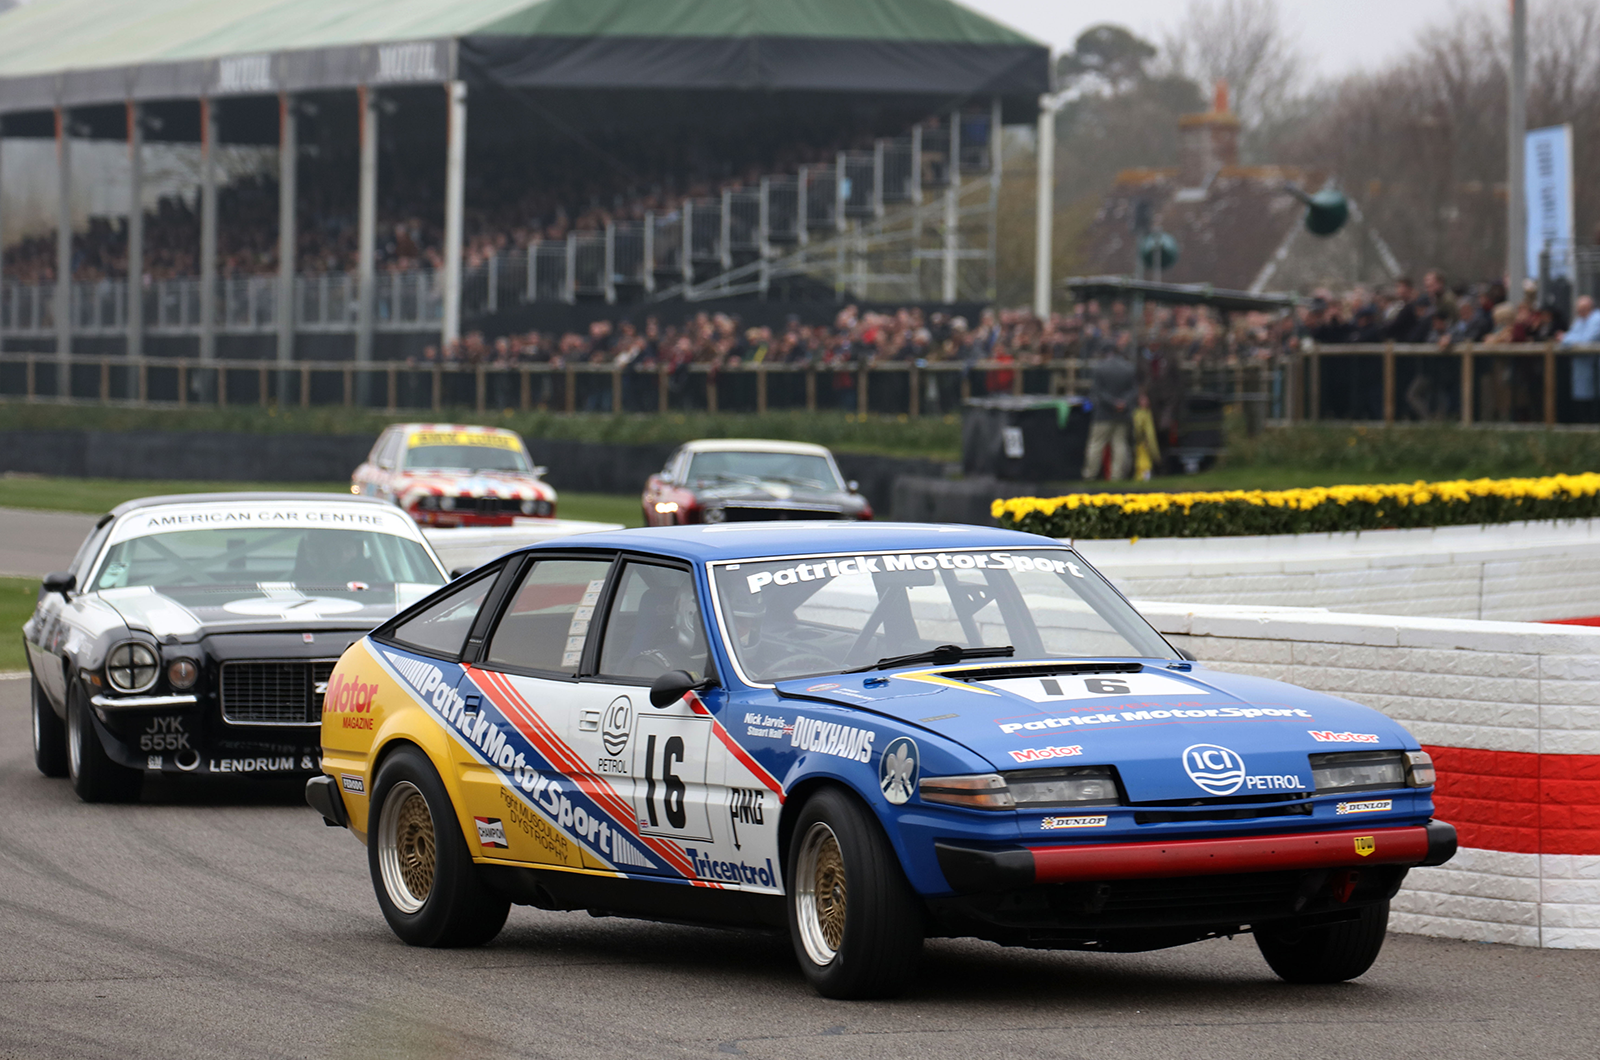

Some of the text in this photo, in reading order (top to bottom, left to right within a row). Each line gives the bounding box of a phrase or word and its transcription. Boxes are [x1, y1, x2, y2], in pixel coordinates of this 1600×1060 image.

[147, 511, 385, 527] AMERICAN CAR CENTRE
[746, 551, 1085, 595] Patrick MotorSport
[324, 673, 379, 714] Motor
[1039, 677, 1132, 696] 16
[1071, 701, 1159, 713] ROVER
[146, 716, 183, 734] JYK
[342, 717, 374, 730] MAGAZINE
[608, 706, 629, 730] ICI
[743, 712, 785, 729] Nick Jarvis
[999, 706, 1313, 734] Patrick MotorSport
[140, 733, 191, 750] 555K
[790, 715, 876, 764] DUCKHAMS
[1310, 731, 1379, 743] Motor
[1009, 745, 1082, 762] Motor
[1192, 750, 1234, 771] ICI
[209, 757, 294, 773] LENDRUM
[301, 756, 313, 770] &
[598, 758, 628, 774] PETROL
[343, 778, 364, 791] FERODO
[645, 734, 686, 829] 16
[1245, 774, 1306, 790] PETROL
[1349, 801, 1391, 811] DUNLOP
[500, 785, 568, 851] Fight MUSCULAR
[1056, 817, 1105, 826] DUNLOP
[478, 824, 506, 840] CHAMPION
[510, 812, 568, 864] DYSTROPHY
[685, 847, 777, 888] Tricentrol
